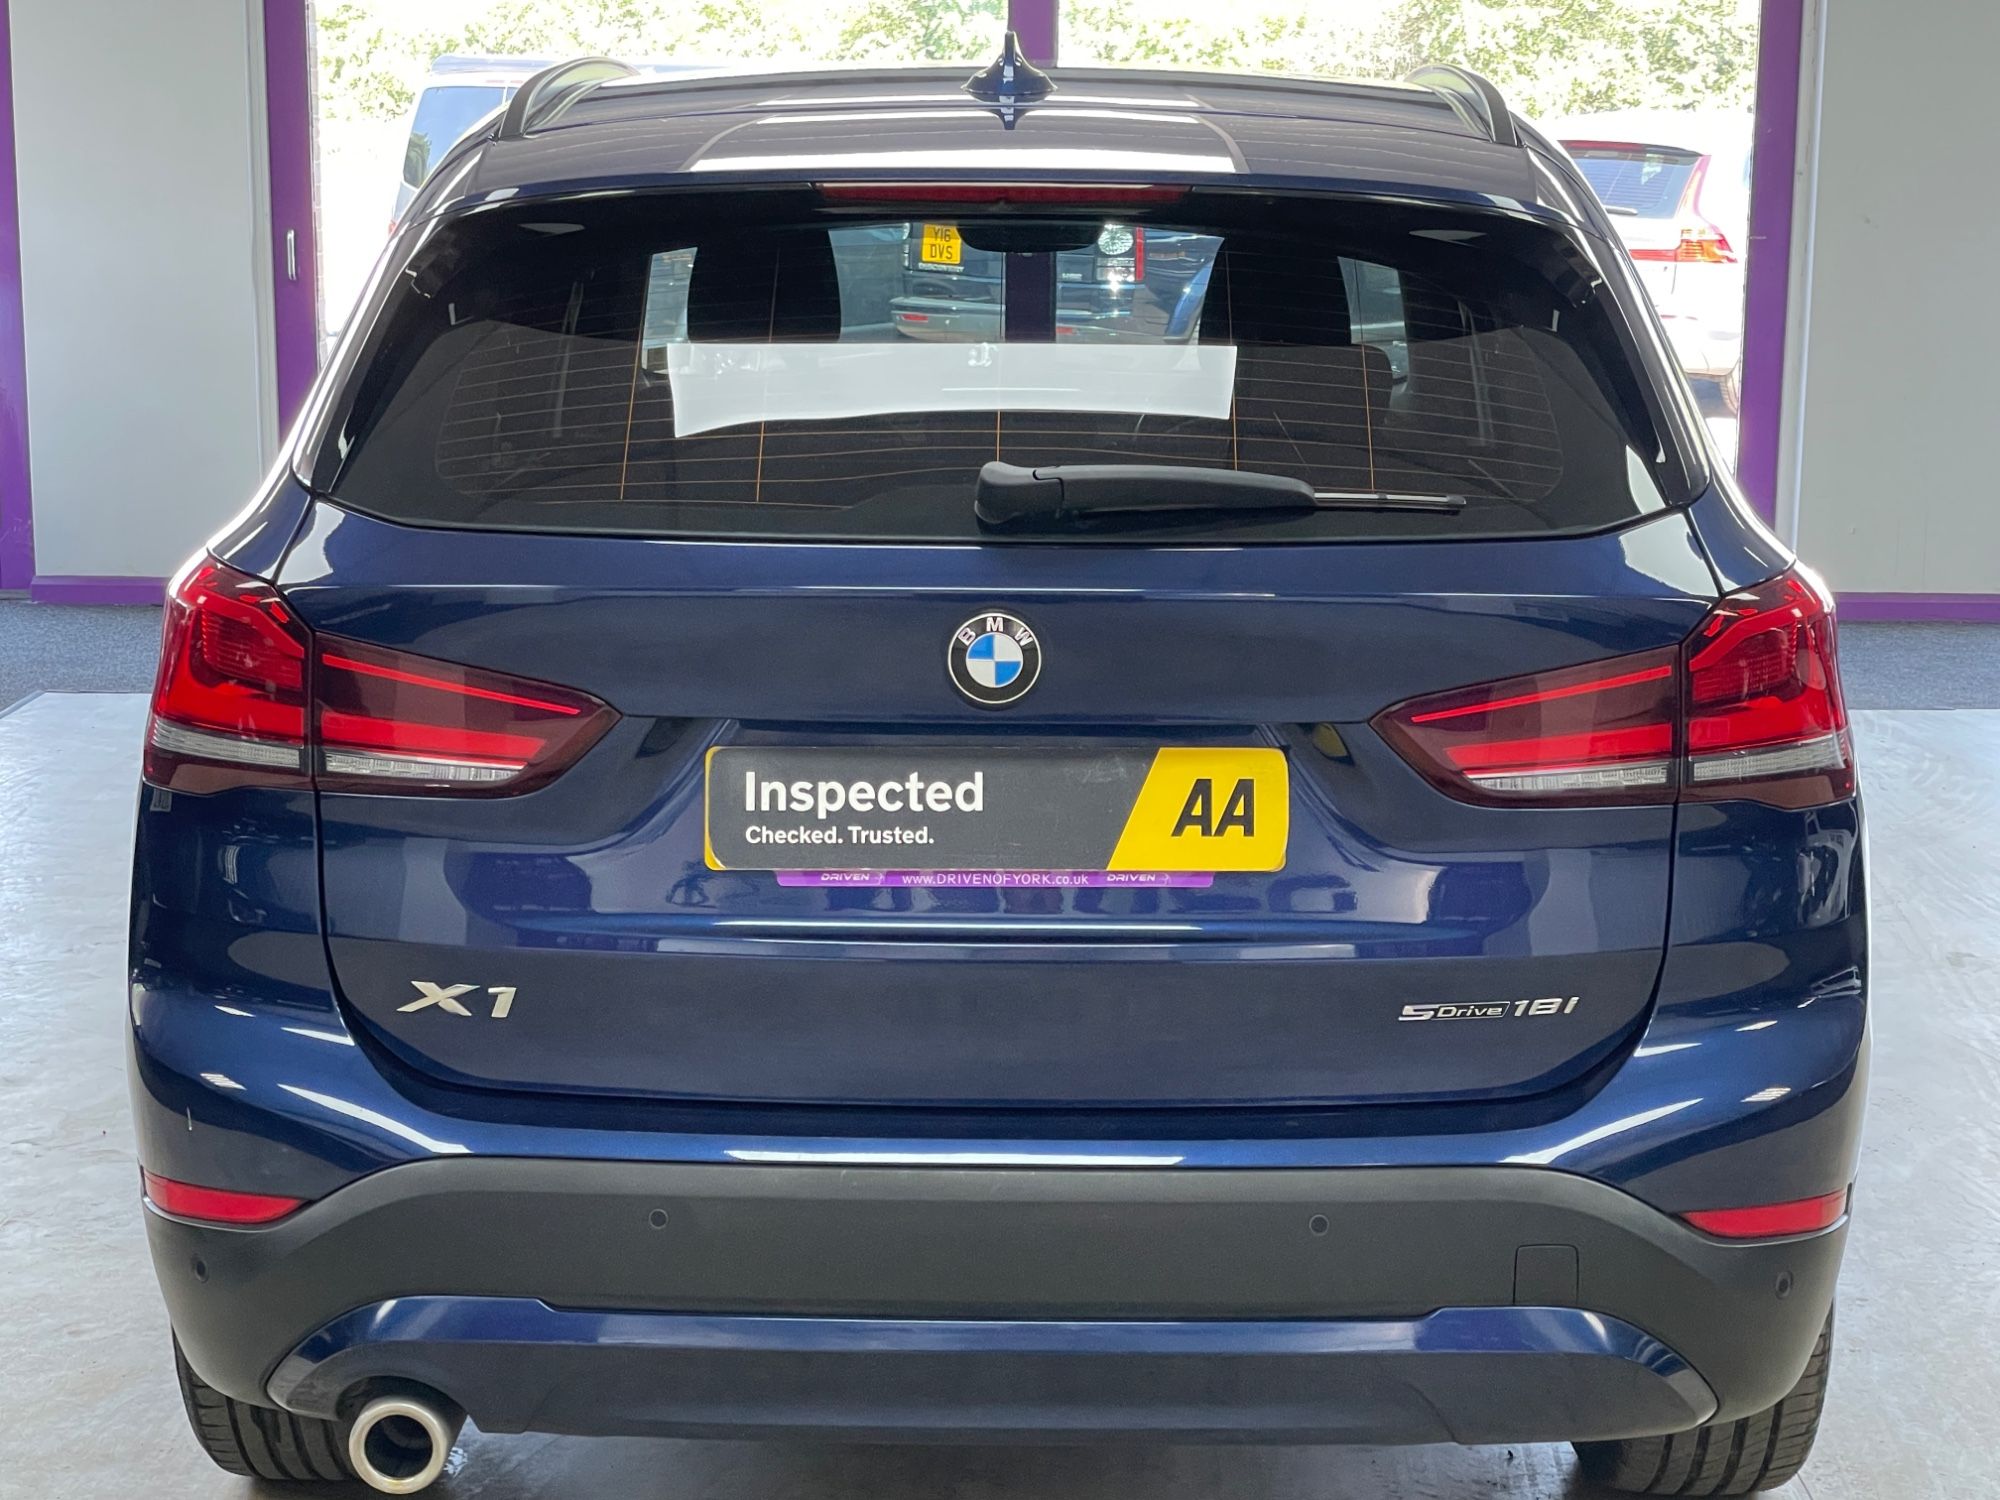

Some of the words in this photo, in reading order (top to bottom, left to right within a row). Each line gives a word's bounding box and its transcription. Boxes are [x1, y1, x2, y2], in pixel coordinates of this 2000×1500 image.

[933, 227, 951, 242] Y16
[929, 244, 953, 260] DVS
[957, 616, 1034, 647] BMW
[745, 771, 984, 819] Inspected
[1171, 778, 1255, 838] AA
[745, 825, 844, 844] Checked.
[847, 825, 935, 844] Trusted.
[820, 872, 870, 882] DRIVEN
[902, 873, 1089, 886] www.DRIVENOFYORK.co.uk
[1106, 872, 1156, 883] DRIVEN
[396, 980, 517, 1018] X1
